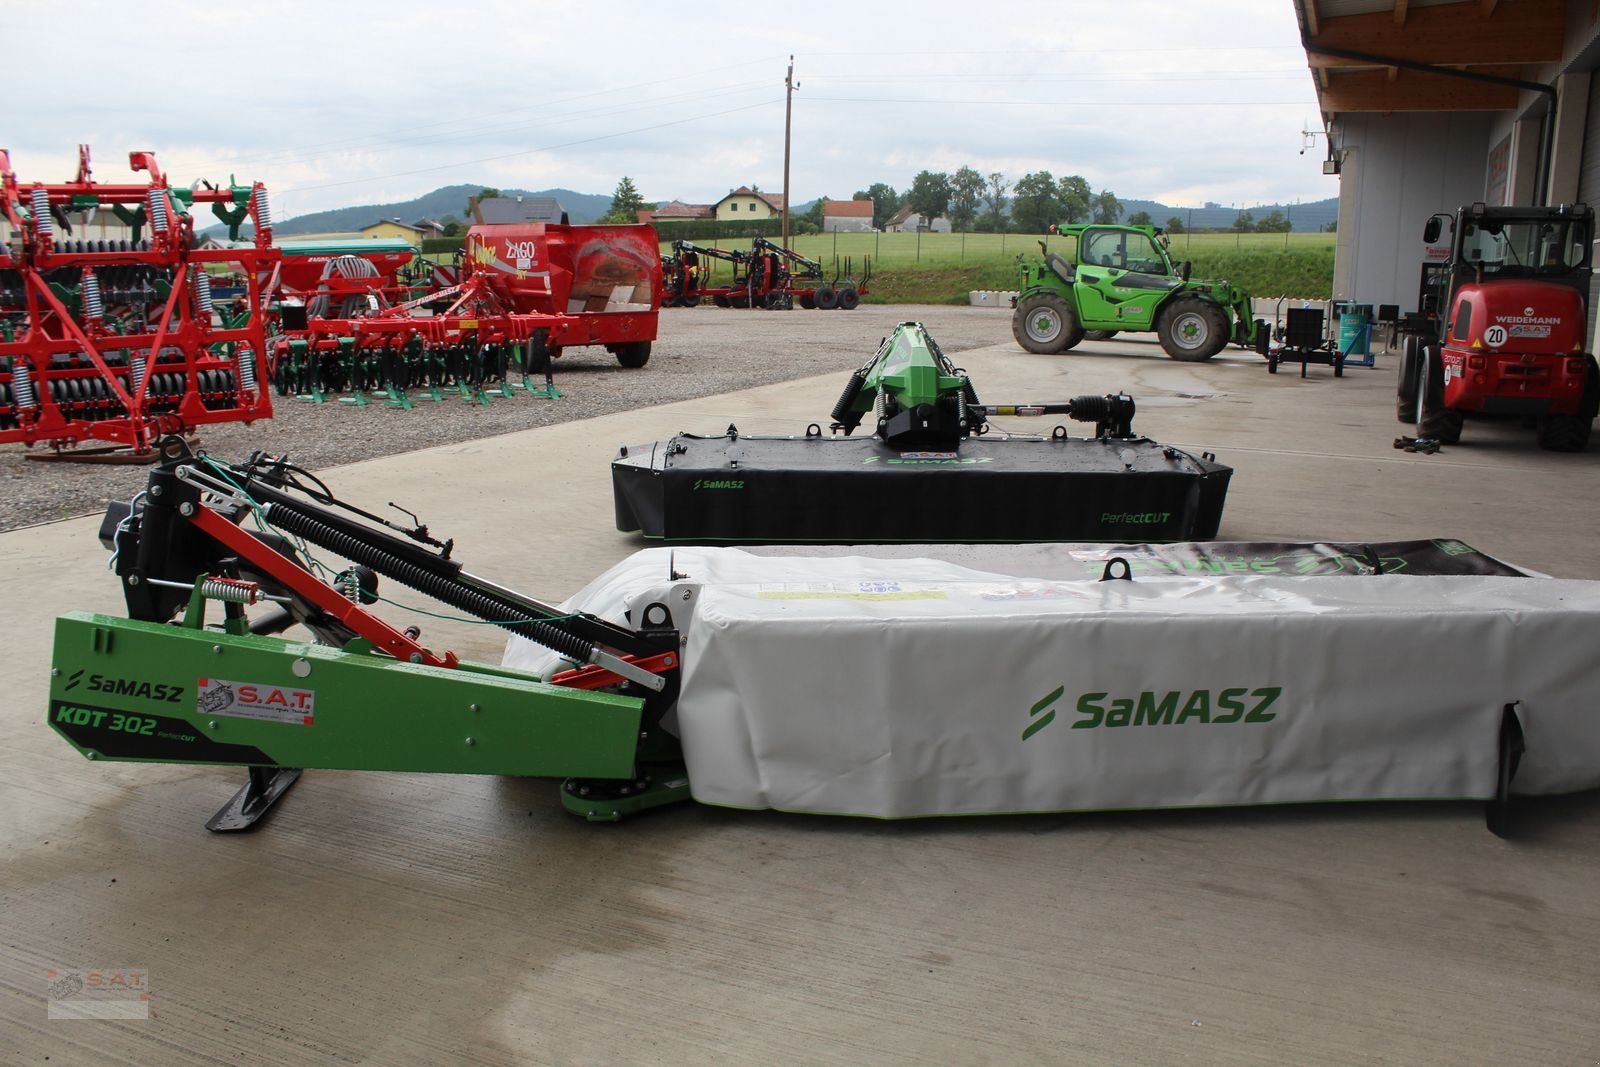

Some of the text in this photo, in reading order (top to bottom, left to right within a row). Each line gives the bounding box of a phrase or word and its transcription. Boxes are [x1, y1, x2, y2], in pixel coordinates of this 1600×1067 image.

[505, 240, 535, 258] ZAGO
[1496, 316, 1561, 325] WEIDEMANN
[1489, 329, 1503, 343] 20
[703, 480, 745, 489] SaMASZ
[1101, 512, 1171, 524] PerfectCUT
[87, 674, 184, 702] SaMASZ
[238, 685, 311, 709] S.A.T.
[1071, 687, 1282, 729] SaMASZ
[56, 706, 106, 728] KDT
[108, 713, 157, 736] 302
